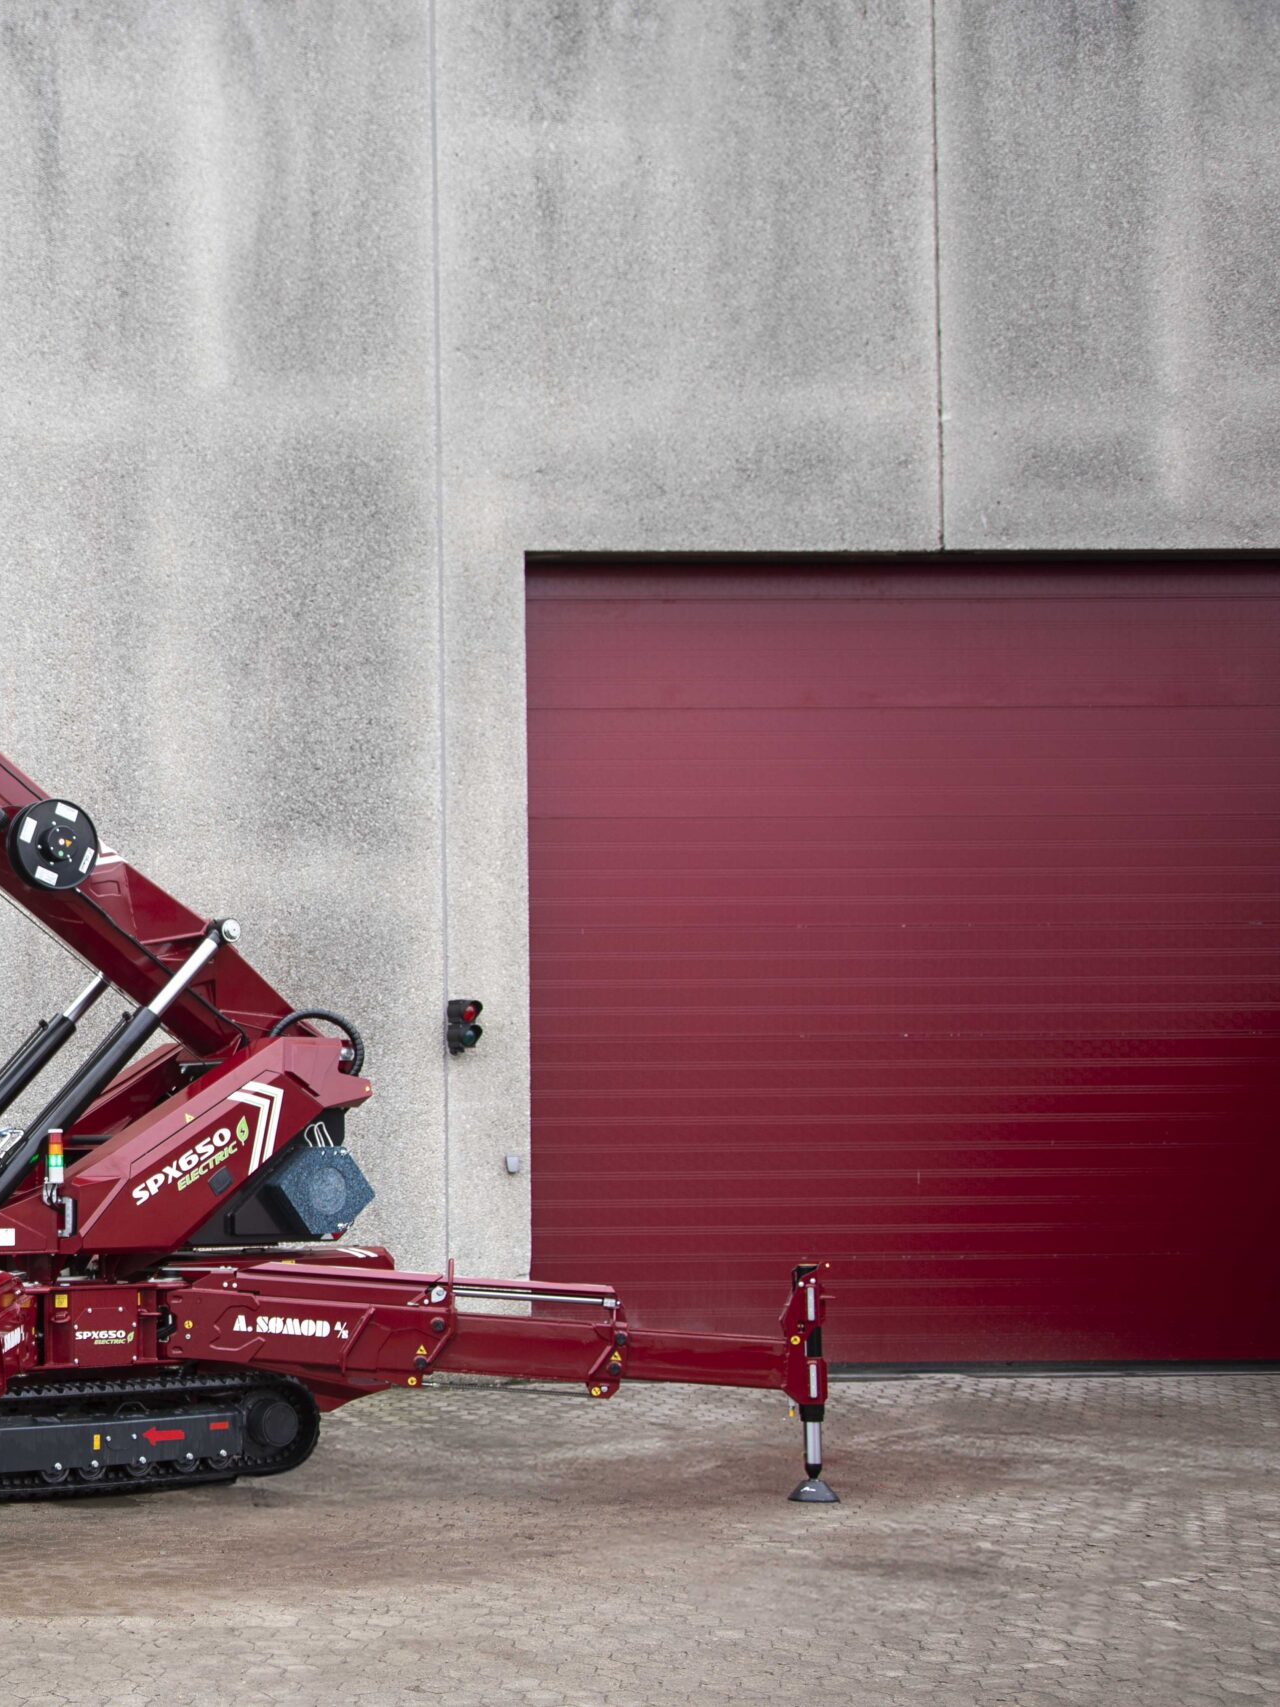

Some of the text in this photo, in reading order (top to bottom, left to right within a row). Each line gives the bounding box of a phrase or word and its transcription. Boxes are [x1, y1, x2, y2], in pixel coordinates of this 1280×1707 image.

[132, 1128, 231, 1206] SPX650
[177, 1141, 238, 1191] ELECTRIC
[75, 1330, 126, 1340] SPX650
[233, 1315, 253, 1332] A.
[256, 1316, 331, 1337] SØMOD
